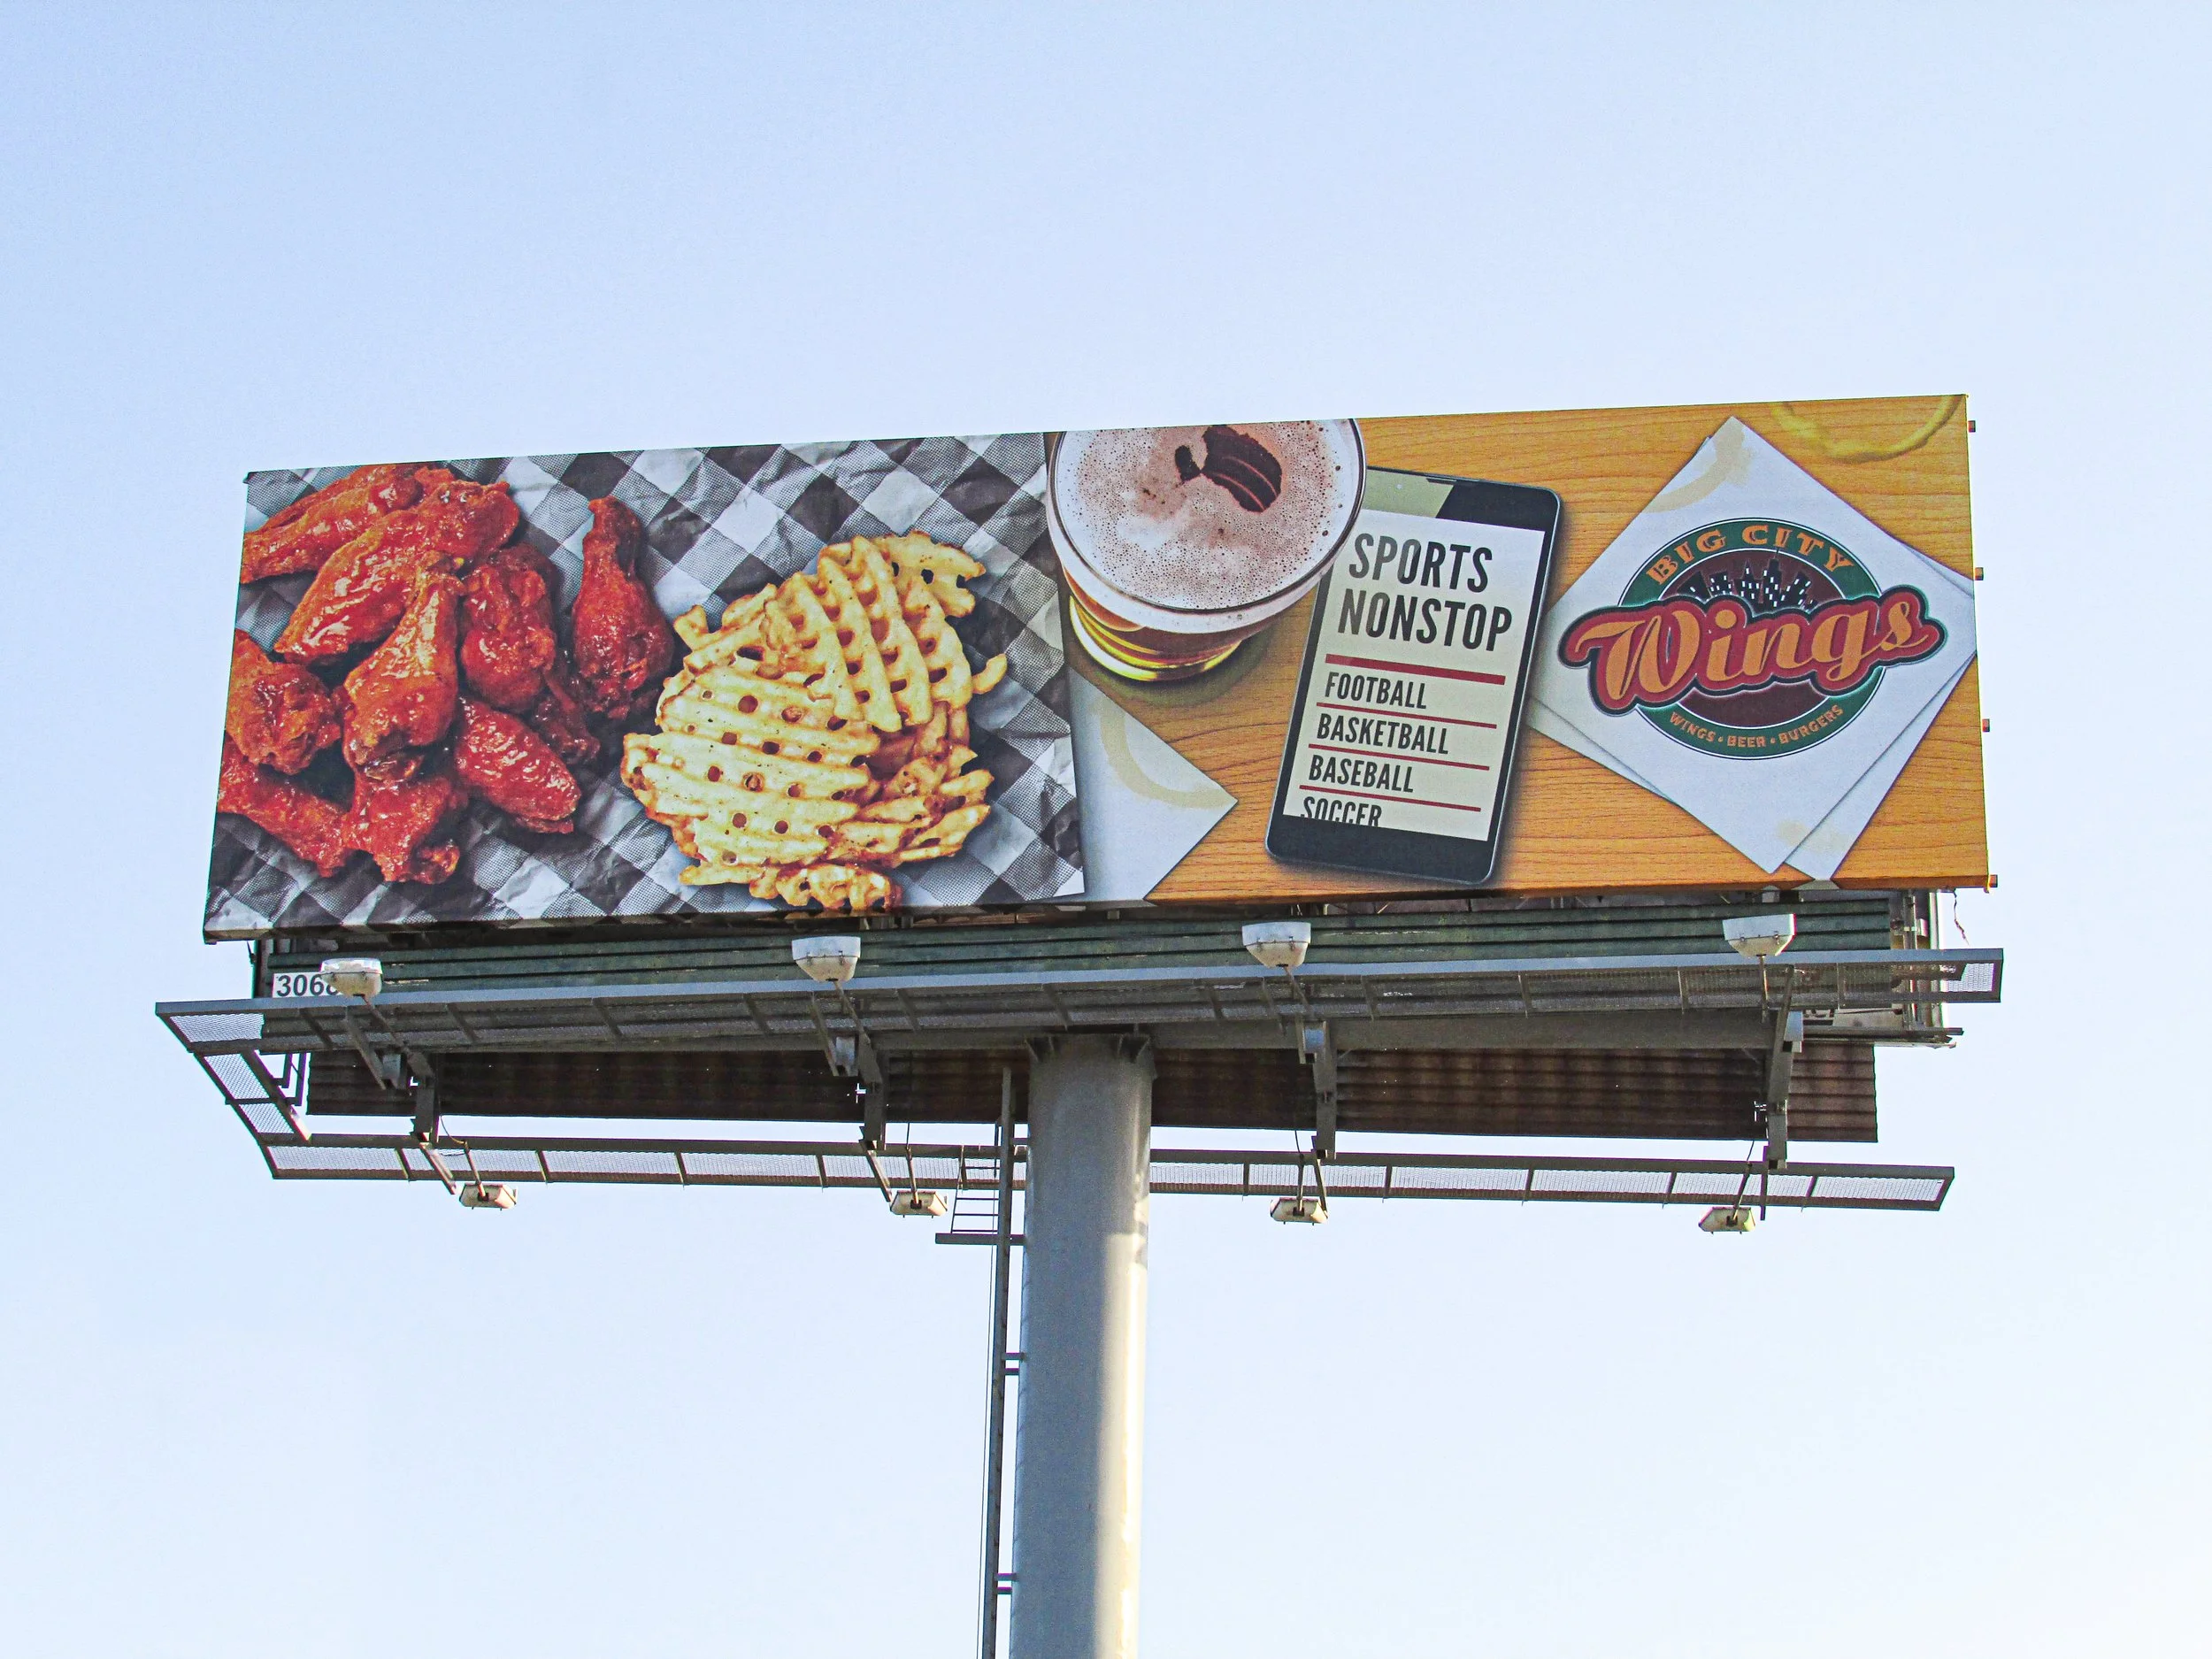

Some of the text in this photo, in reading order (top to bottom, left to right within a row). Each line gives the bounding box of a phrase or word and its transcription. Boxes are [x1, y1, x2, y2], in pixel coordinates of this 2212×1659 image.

[1348, 533, 1493, 593] SPORTS
[1645, 525, 1855, 585] BIG CITY
[1337, 588, 1512, 651] NONSTOP
[1566, 590, 1937, 710] Wings
[1325, 672, 1427, 710] FOOTBALL
[1317, 713, 1448, 755] BASKETBALL
[1670, 704, 1843, 748] WINGS BEER BURGERS
[1308, 755, 1414, 793] BASEBALL
